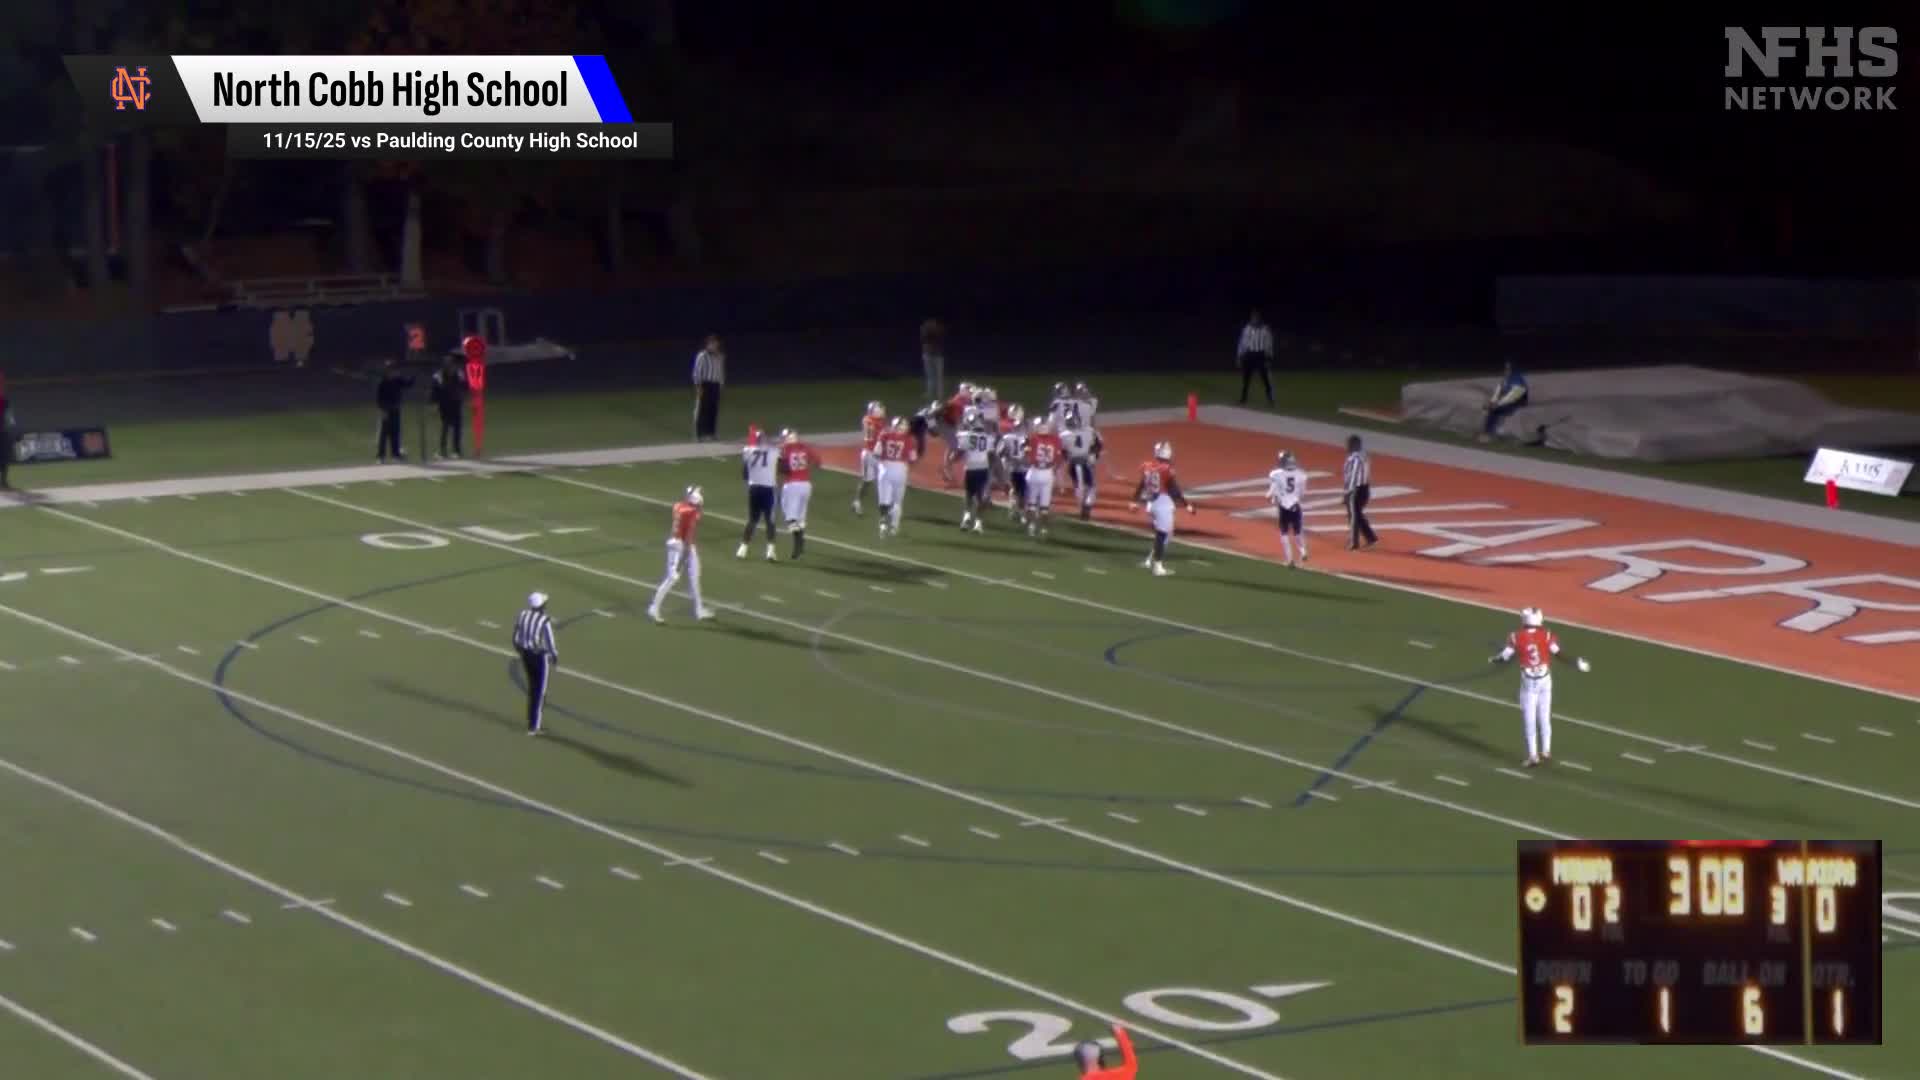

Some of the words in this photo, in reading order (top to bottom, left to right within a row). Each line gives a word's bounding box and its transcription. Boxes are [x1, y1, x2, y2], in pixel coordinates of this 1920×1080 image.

[752, 450, 769, 467] 71
[1286, 477, 1295, 493] 5
[1182, 470, 1920, 642] WARR
[1527, 643, 1540, 665] 3
